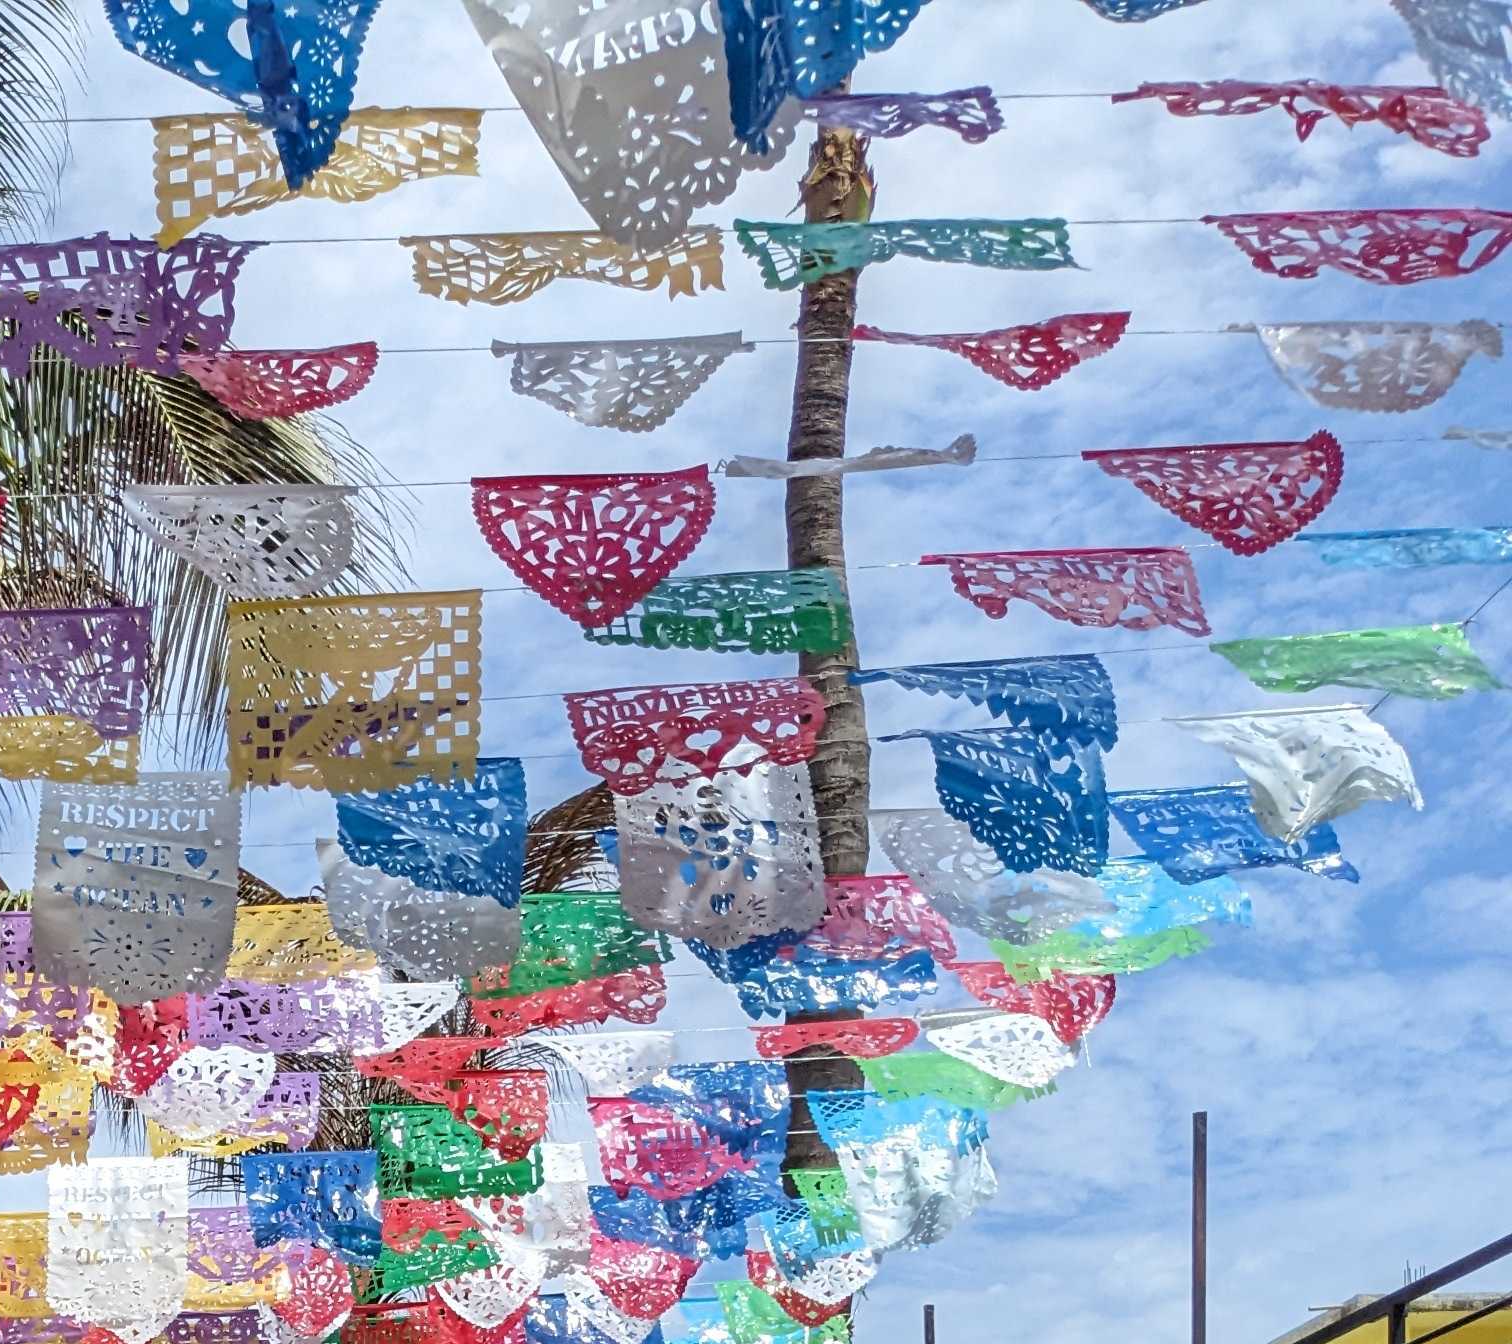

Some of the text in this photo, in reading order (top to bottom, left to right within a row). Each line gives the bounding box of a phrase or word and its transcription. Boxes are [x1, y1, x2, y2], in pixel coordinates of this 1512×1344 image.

[514, 497, 680, 550] AMOR
[582, 682, 800, 728] NOVIEMBRE
[60, 801, 217, 832] RESPECT
[98, 839, 171, 868] THE
